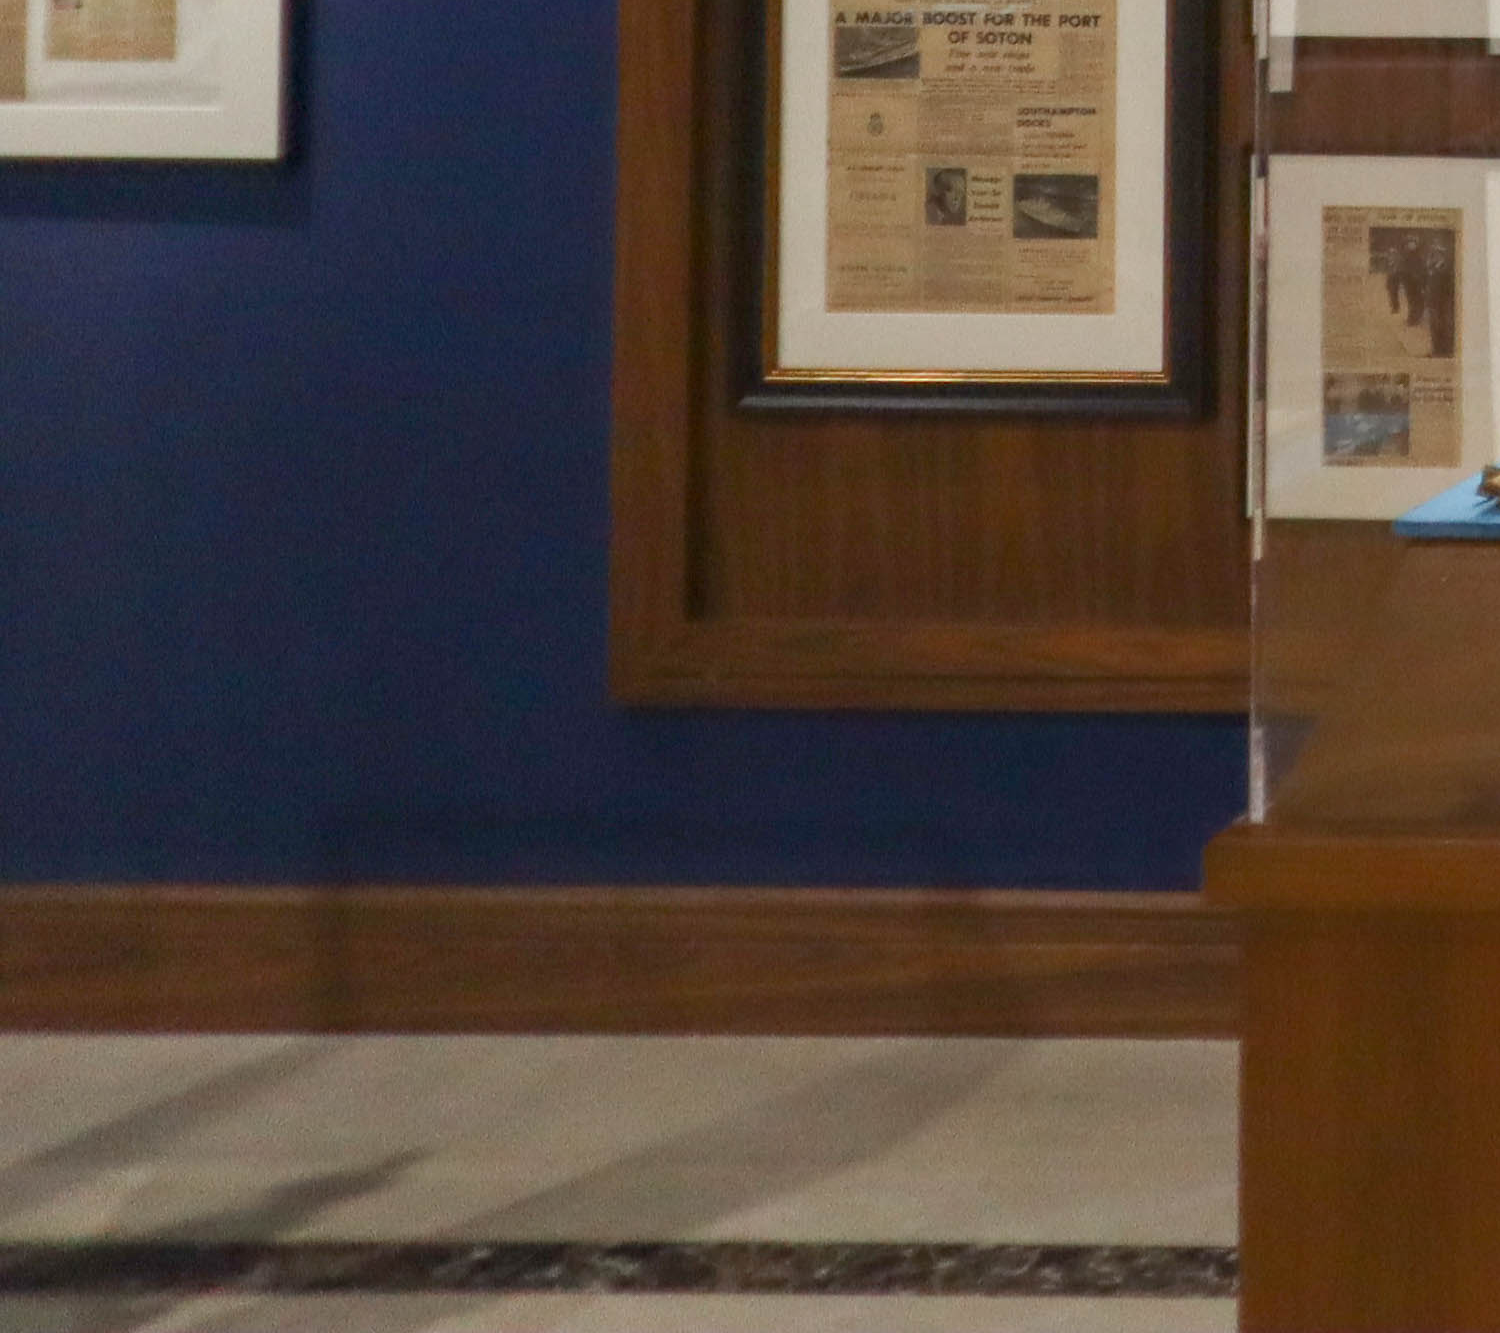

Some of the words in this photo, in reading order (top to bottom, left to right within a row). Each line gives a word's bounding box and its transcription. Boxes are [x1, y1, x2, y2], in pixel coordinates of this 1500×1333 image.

[835, 12, 847, 23] A
[923, 12, 977, 25] BOOST
[983, 13, 1015, 26] FOR
[1022, 14, 1051, 27] THE
[1058, 15, 1101, 28] PORT
[948, 32, 968, 44] OF
[976, 31, 1032, 44] SOTON
